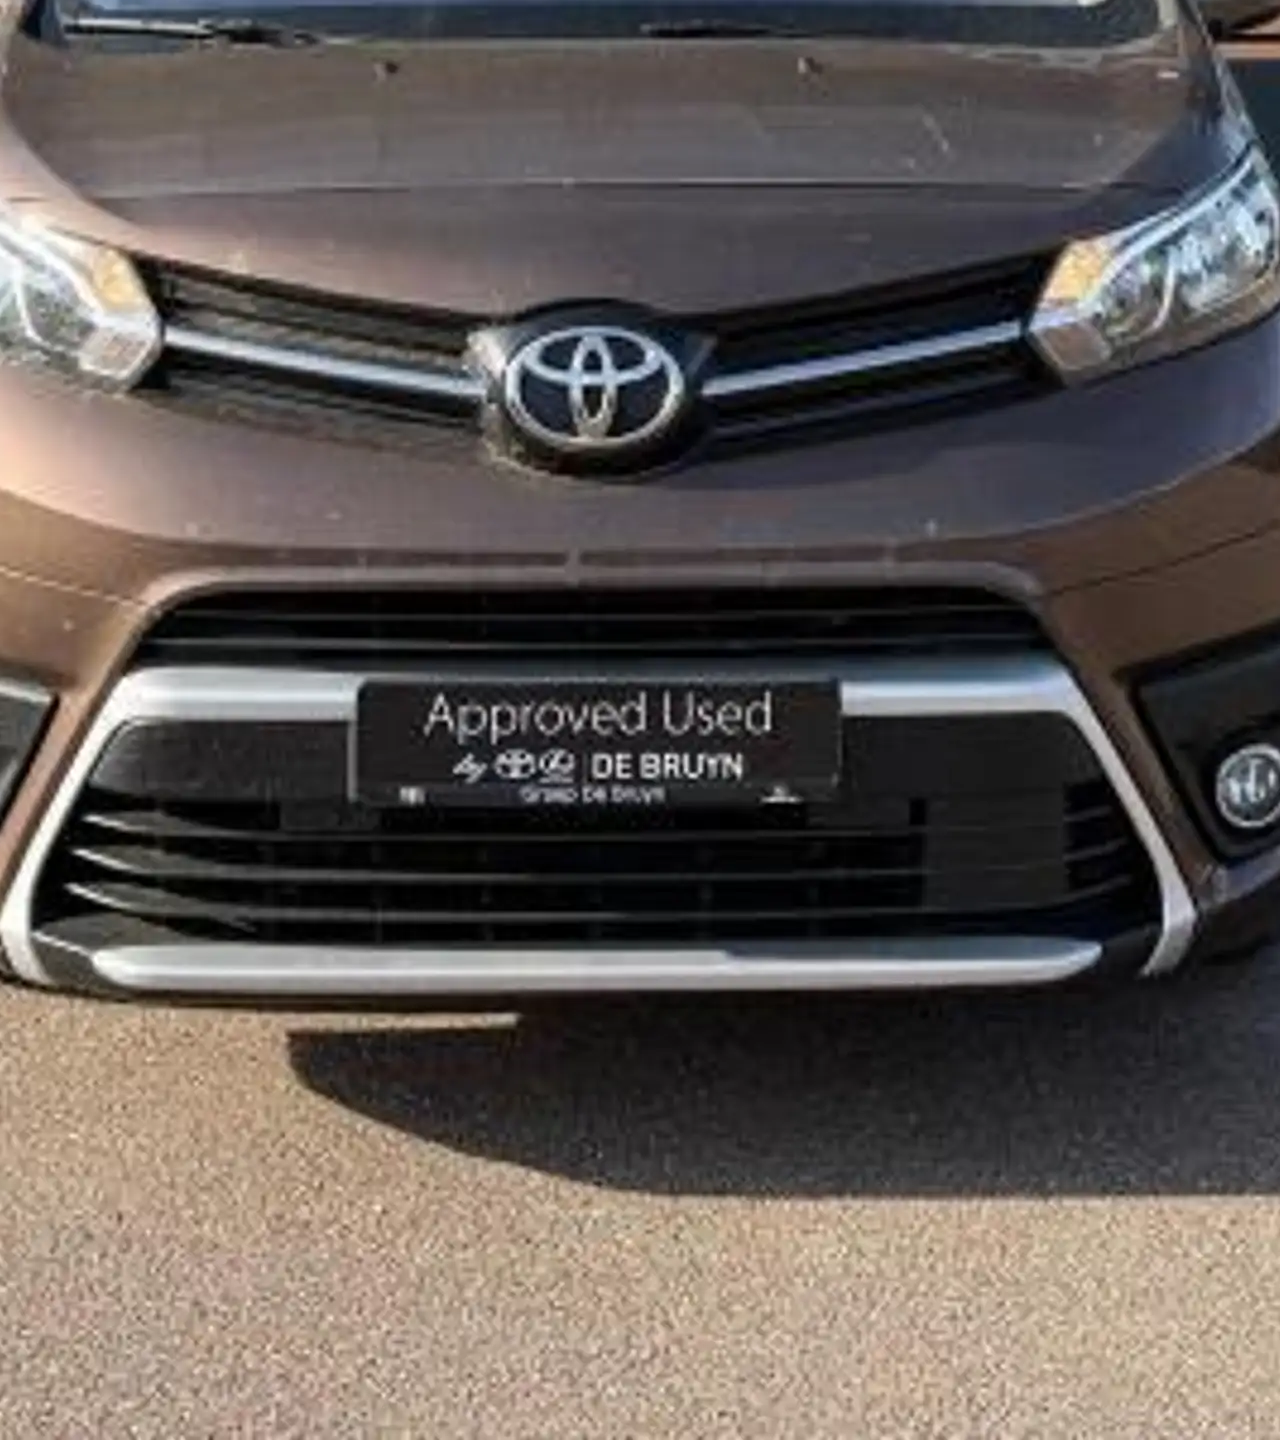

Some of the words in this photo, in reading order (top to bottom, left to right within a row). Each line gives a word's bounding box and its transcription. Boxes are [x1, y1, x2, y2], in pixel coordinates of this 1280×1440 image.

[423, 692, 647, 744] Approved
[662, 691, 773, 736] Used
[590, 752, 632, 782] DE
[640, 752, 744, 782] BRUYN
